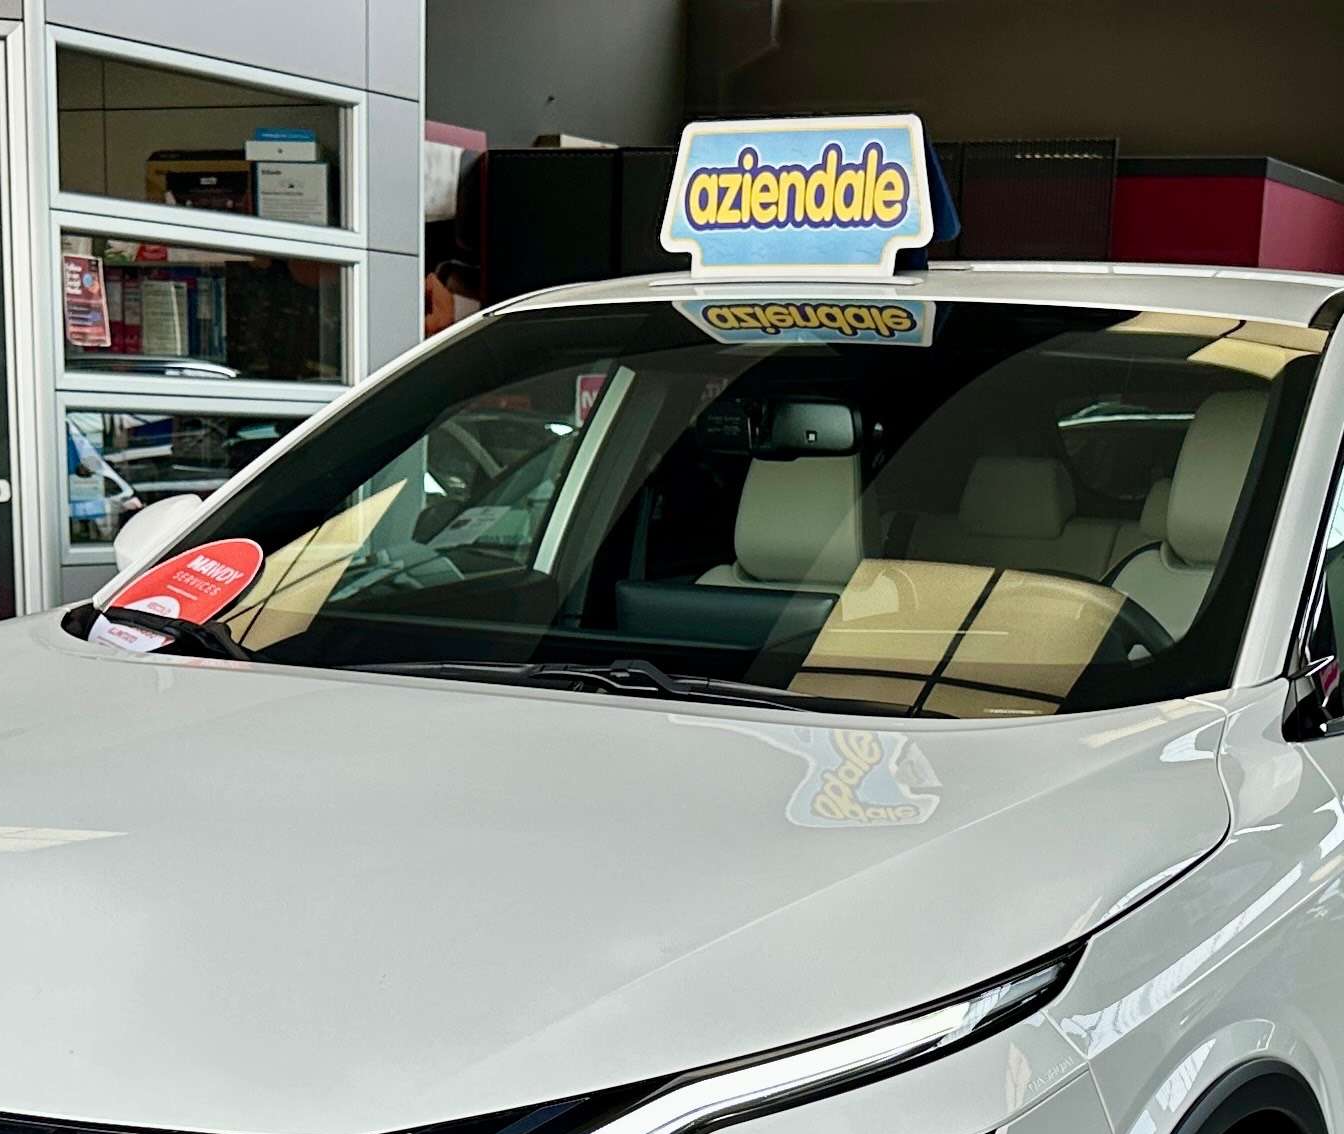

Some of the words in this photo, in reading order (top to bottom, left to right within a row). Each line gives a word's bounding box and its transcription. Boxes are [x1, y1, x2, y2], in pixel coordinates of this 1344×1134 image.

[687, 144, 907, 228] aziendale
[171, 570, 222, 596] SERVICES
[186, 555, 245, 584] MAWDY
